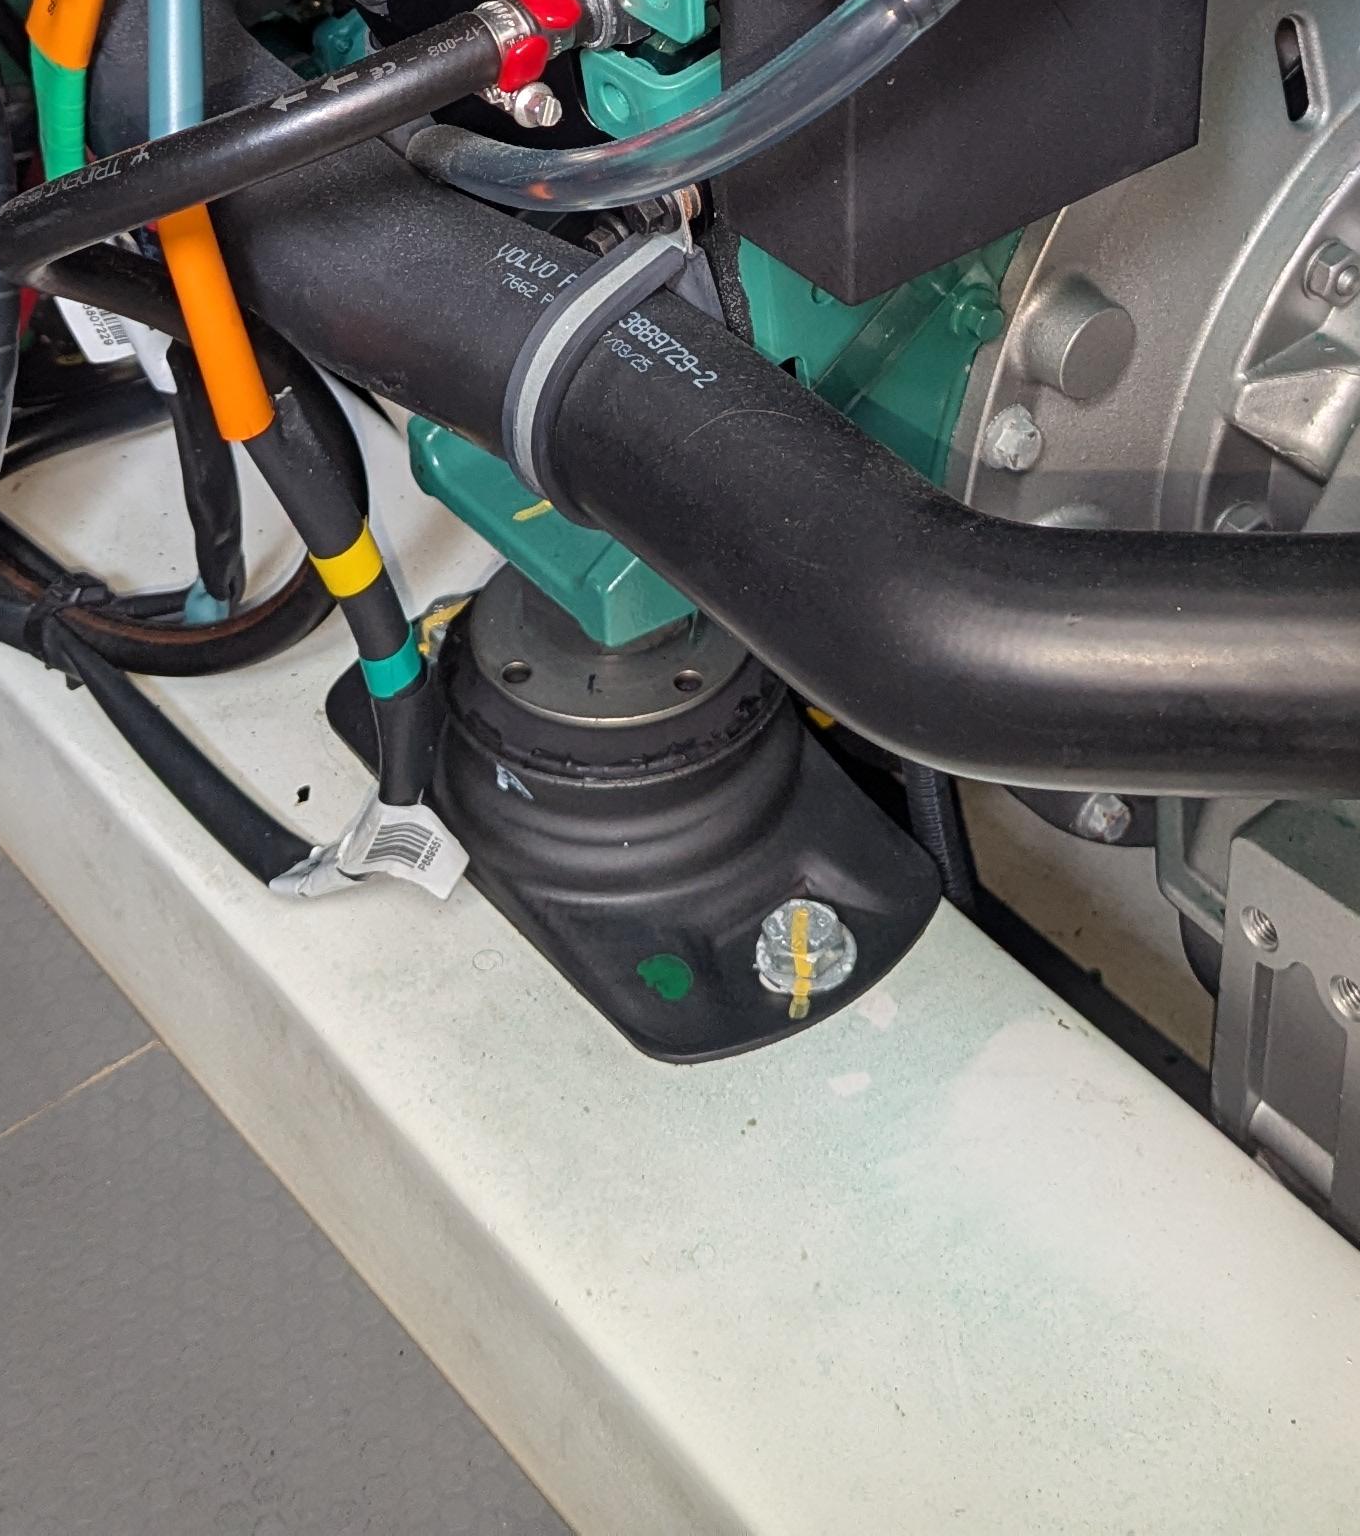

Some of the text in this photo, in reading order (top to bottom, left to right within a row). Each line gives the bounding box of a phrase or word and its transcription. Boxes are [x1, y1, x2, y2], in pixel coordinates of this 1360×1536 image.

[44, 159, 122, 198] TRIDENT
[495, 242, 559, 279] VOLVO
[501, 272, 539, 299] 7662
[618, 311, 718, 390] 3889729-2
